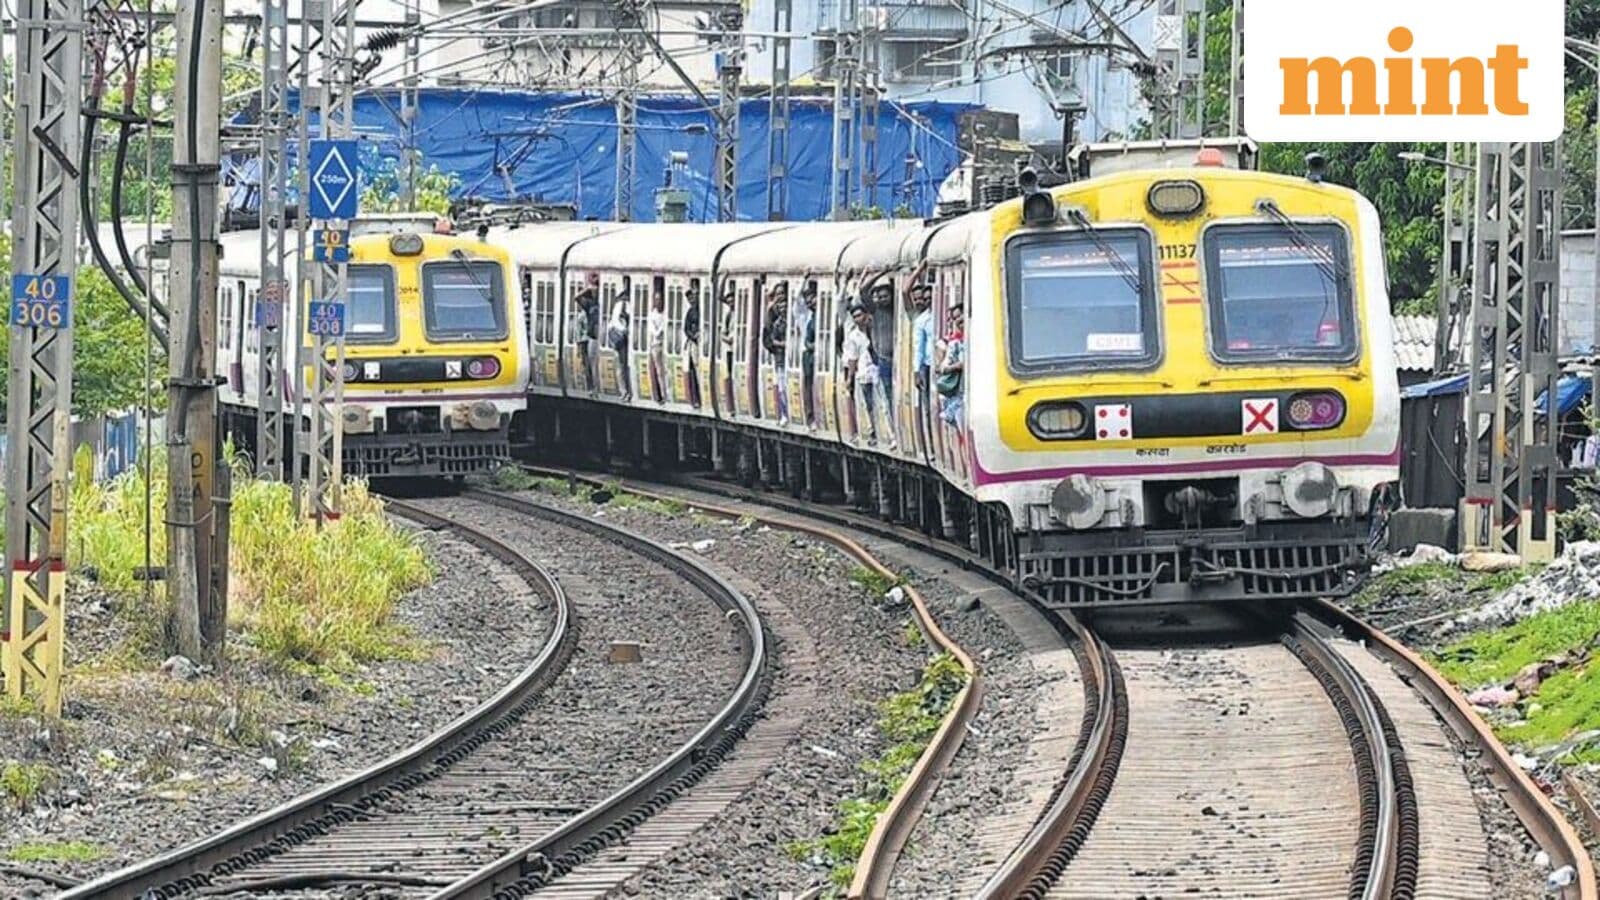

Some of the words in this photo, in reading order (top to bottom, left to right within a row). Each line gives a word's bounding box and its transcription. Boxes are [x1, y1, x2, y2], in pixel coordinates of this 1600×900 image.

[1158, 244, 1197, 260] 11137
[25, 278, 56, 299] 40
[16, 302, 61, 326] 306
[318, 304, 336, 317] 40
[311, 319, 340, 334] 308
